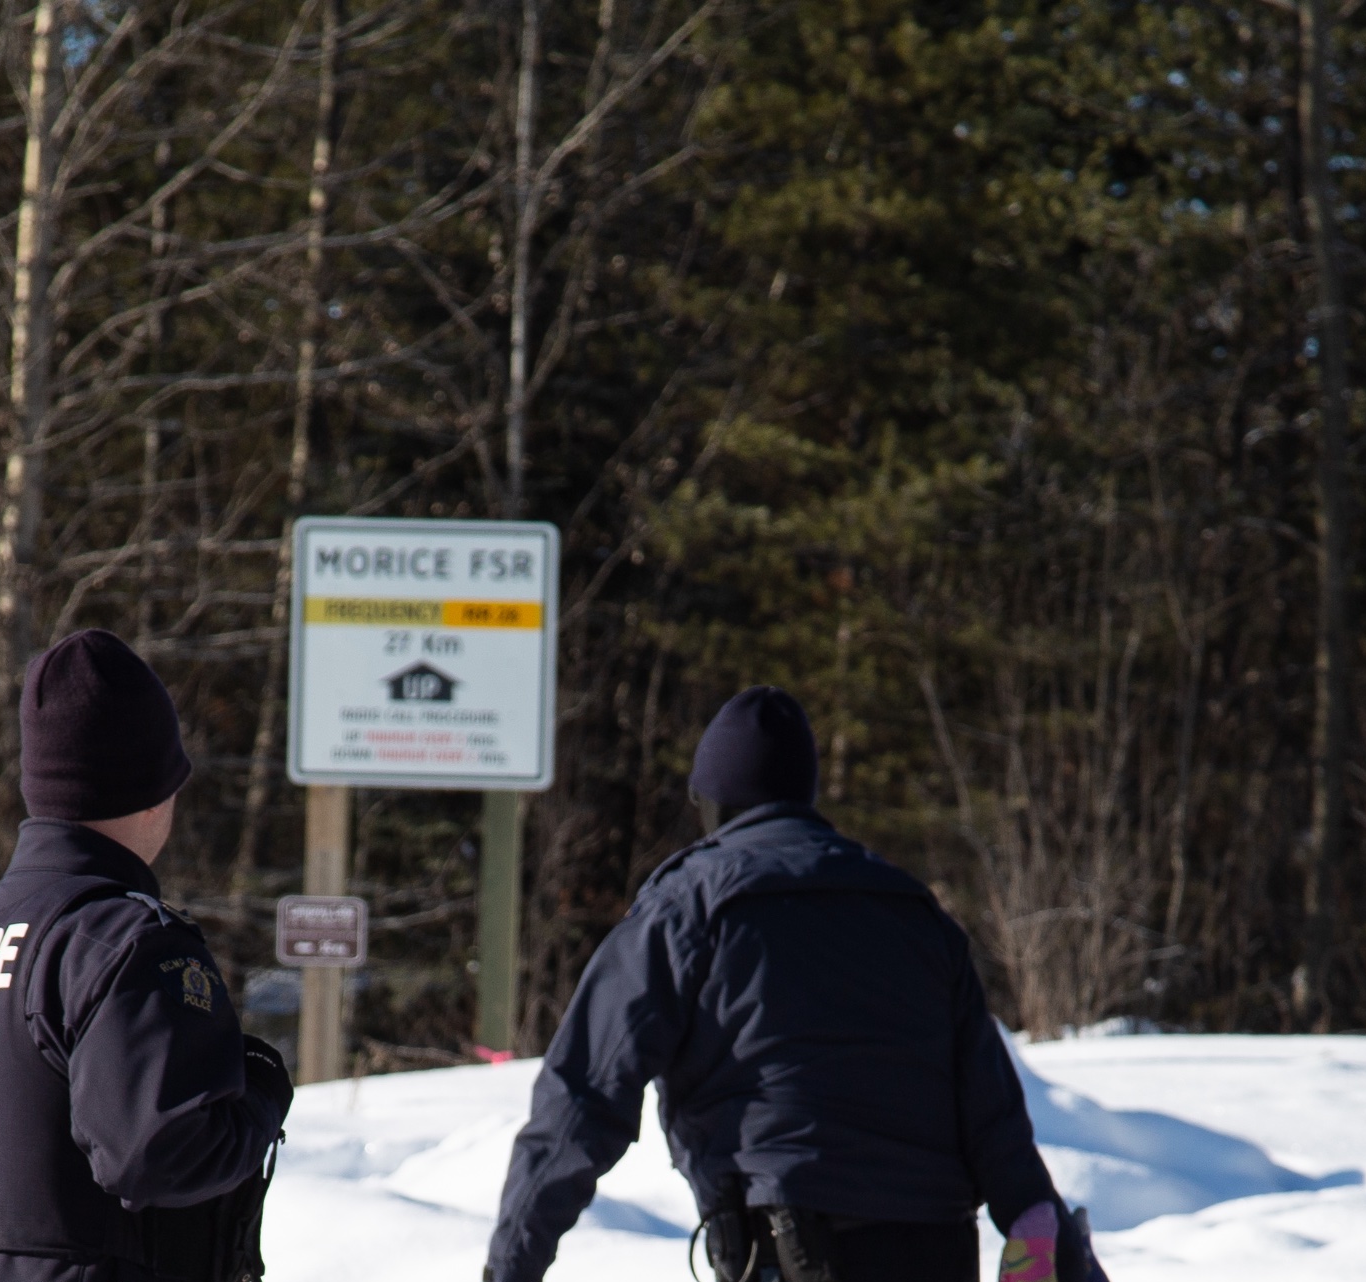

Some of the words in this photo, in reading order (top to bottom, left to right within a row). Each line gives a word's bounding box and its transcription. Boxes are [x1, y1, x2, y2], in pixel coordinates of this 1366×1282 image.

[315, 546, 450, 579] MORICE
[469, 548, 533, 580] FSR
[403, 673, 442, 699] UP
[183, 993, 212, 1012] POLICE
